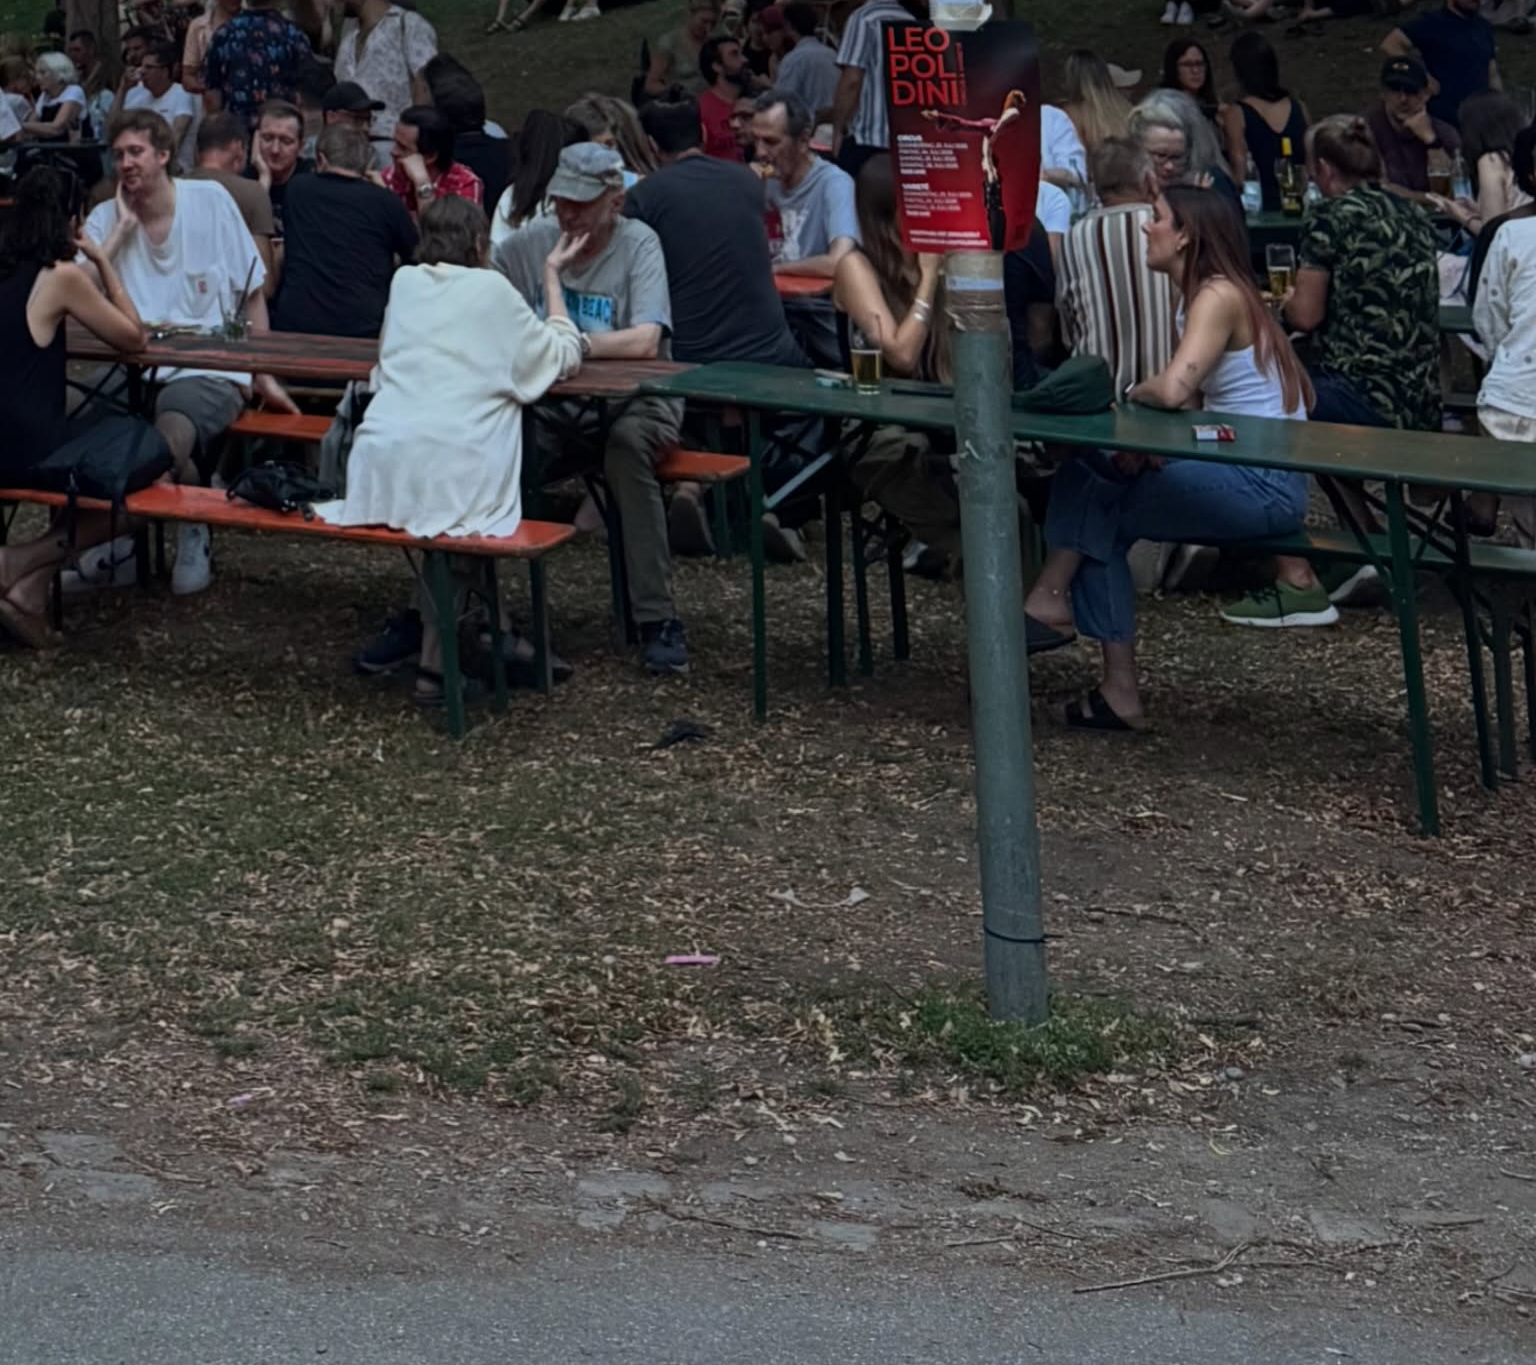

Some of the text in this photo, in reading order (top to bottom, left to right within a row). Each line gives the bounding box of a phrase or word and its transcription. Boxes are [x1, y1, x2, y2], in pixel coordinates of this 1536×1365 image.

[888, 26, 951, 53] LEO
[890, 53, 957, 80] POL
[891, 79, 959, 106] DINI
